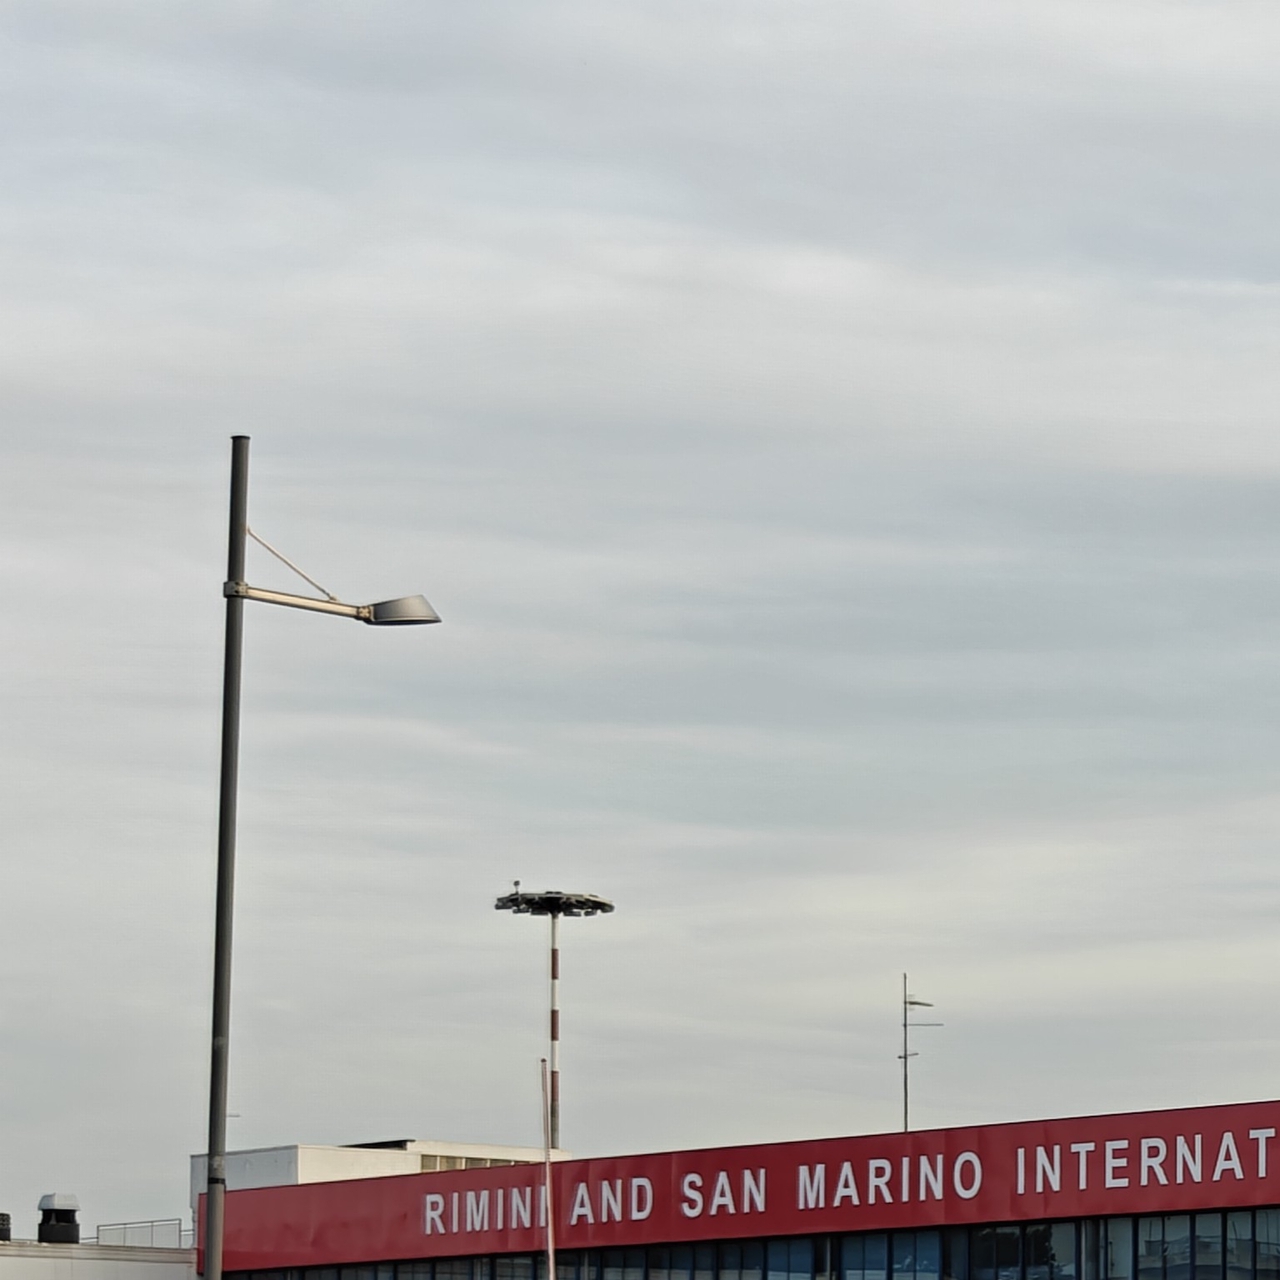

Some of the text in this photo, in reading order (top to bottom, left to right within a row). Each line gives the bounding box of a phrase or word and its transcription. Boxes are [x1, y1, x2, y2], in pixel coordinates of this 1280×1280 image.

[424, 1184, 547, 1235] RIMINI
[570, 1177, 653, 1226] AND
[681, 1168, 766, 1218] SAN
[798, 1150, 983, 1210] MARINO
